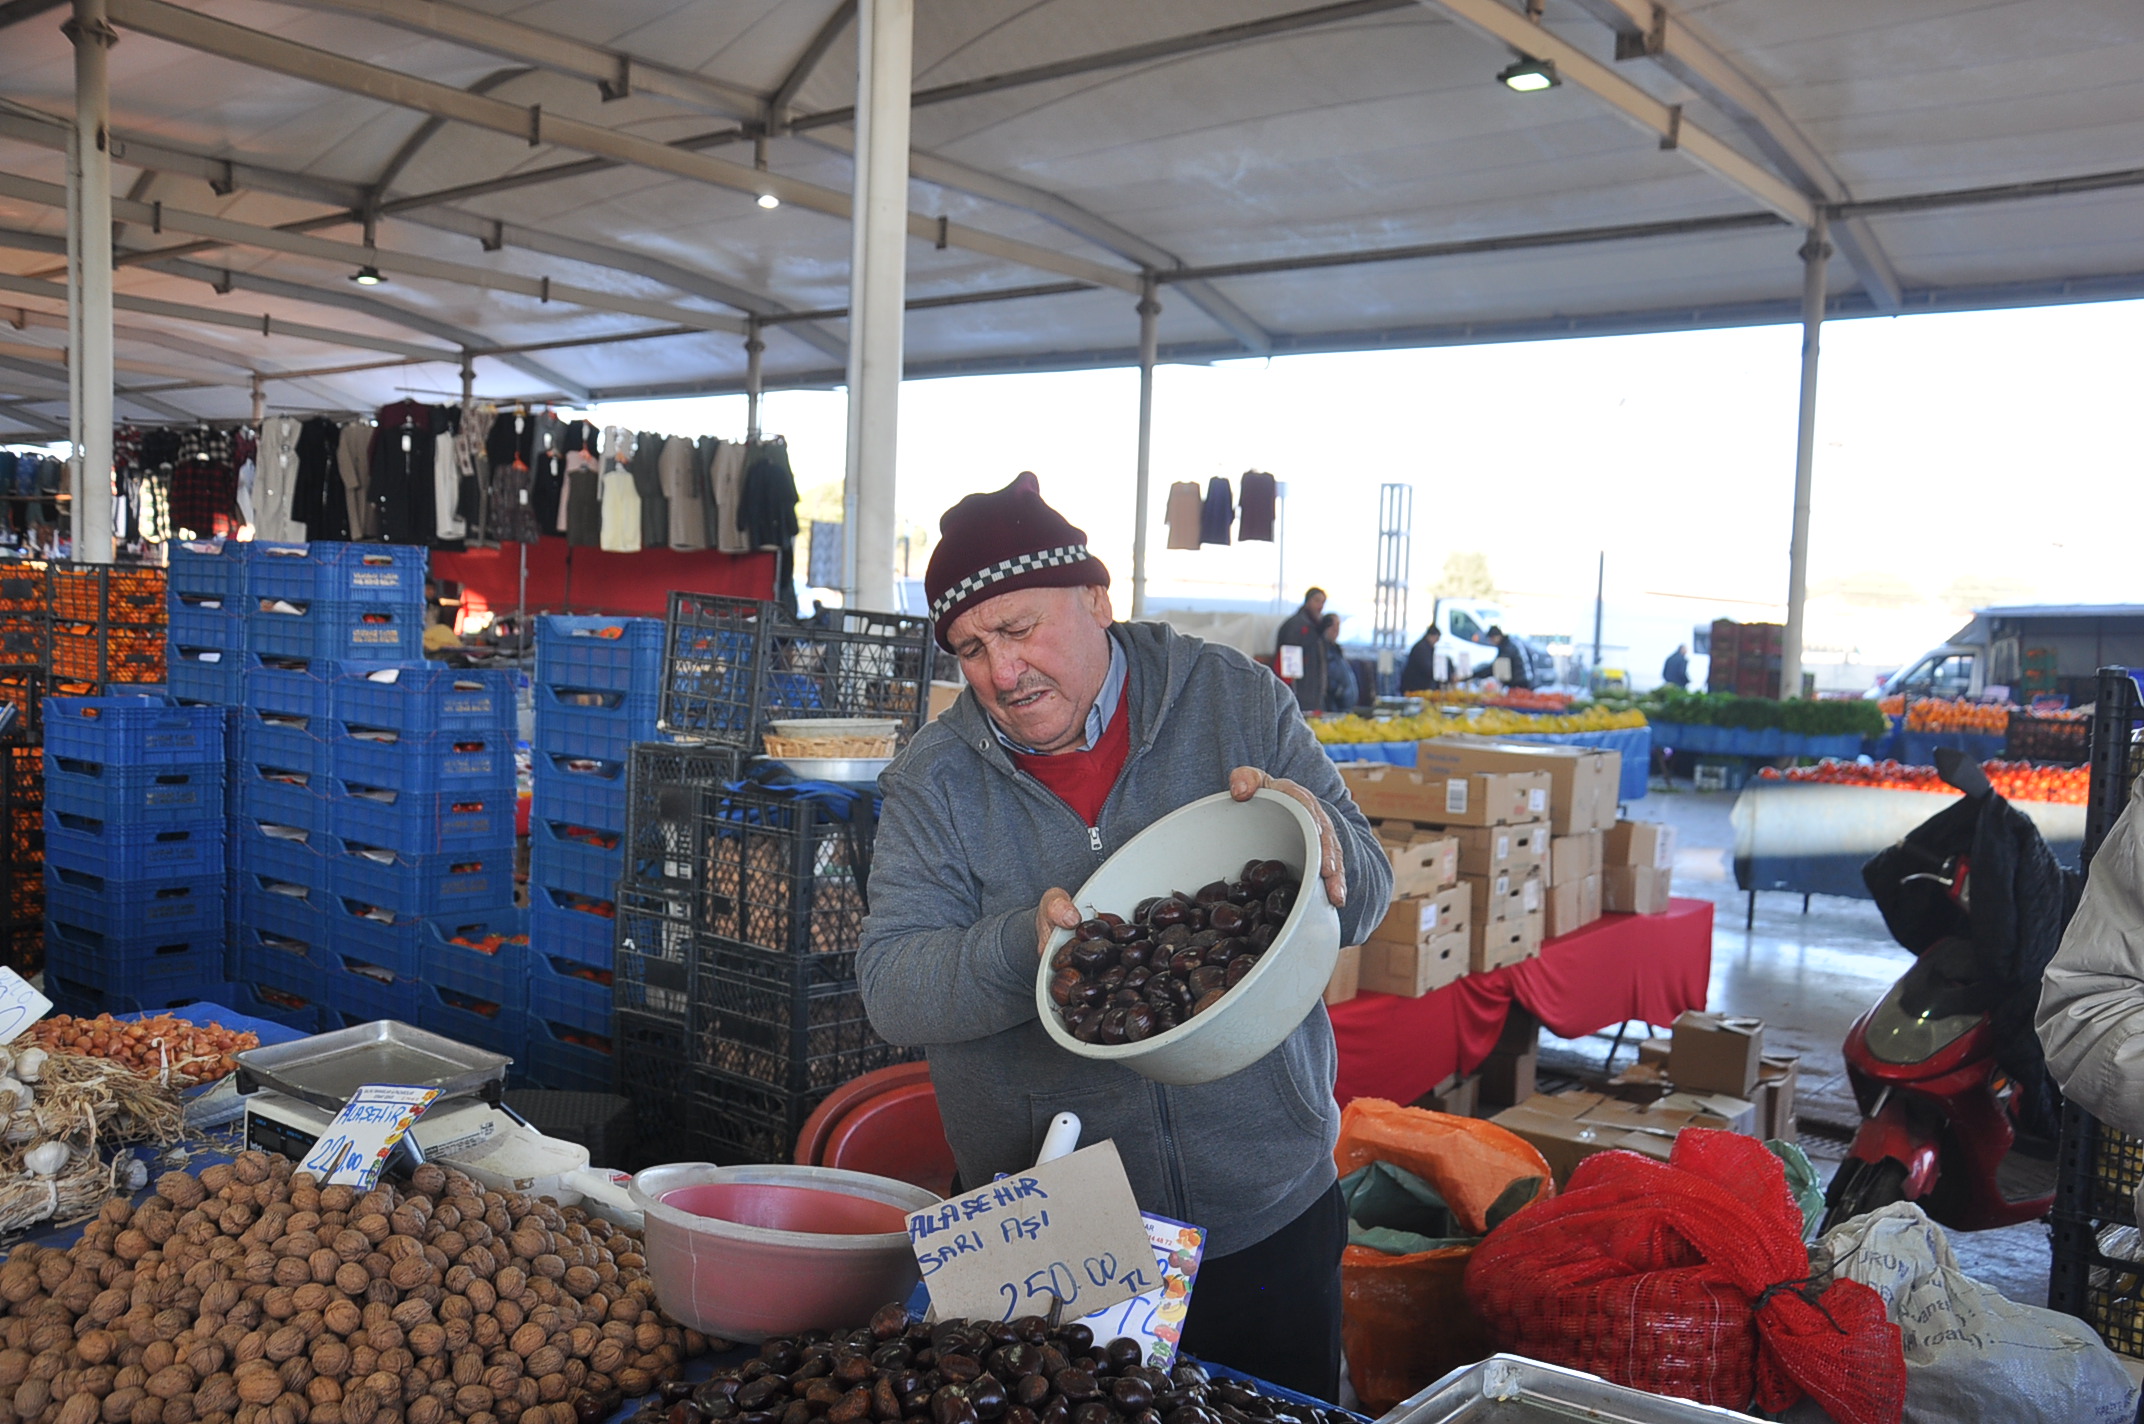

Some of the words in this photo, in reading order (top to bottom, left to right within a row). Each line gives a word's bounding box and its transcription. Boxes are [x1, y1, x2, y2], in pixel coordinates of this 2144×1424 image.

[917, 1230, 984, 1277] SARI
[1000, 1209, 1050, 1243] AŞI
[1118, 1268, 1152, 1293] TL
